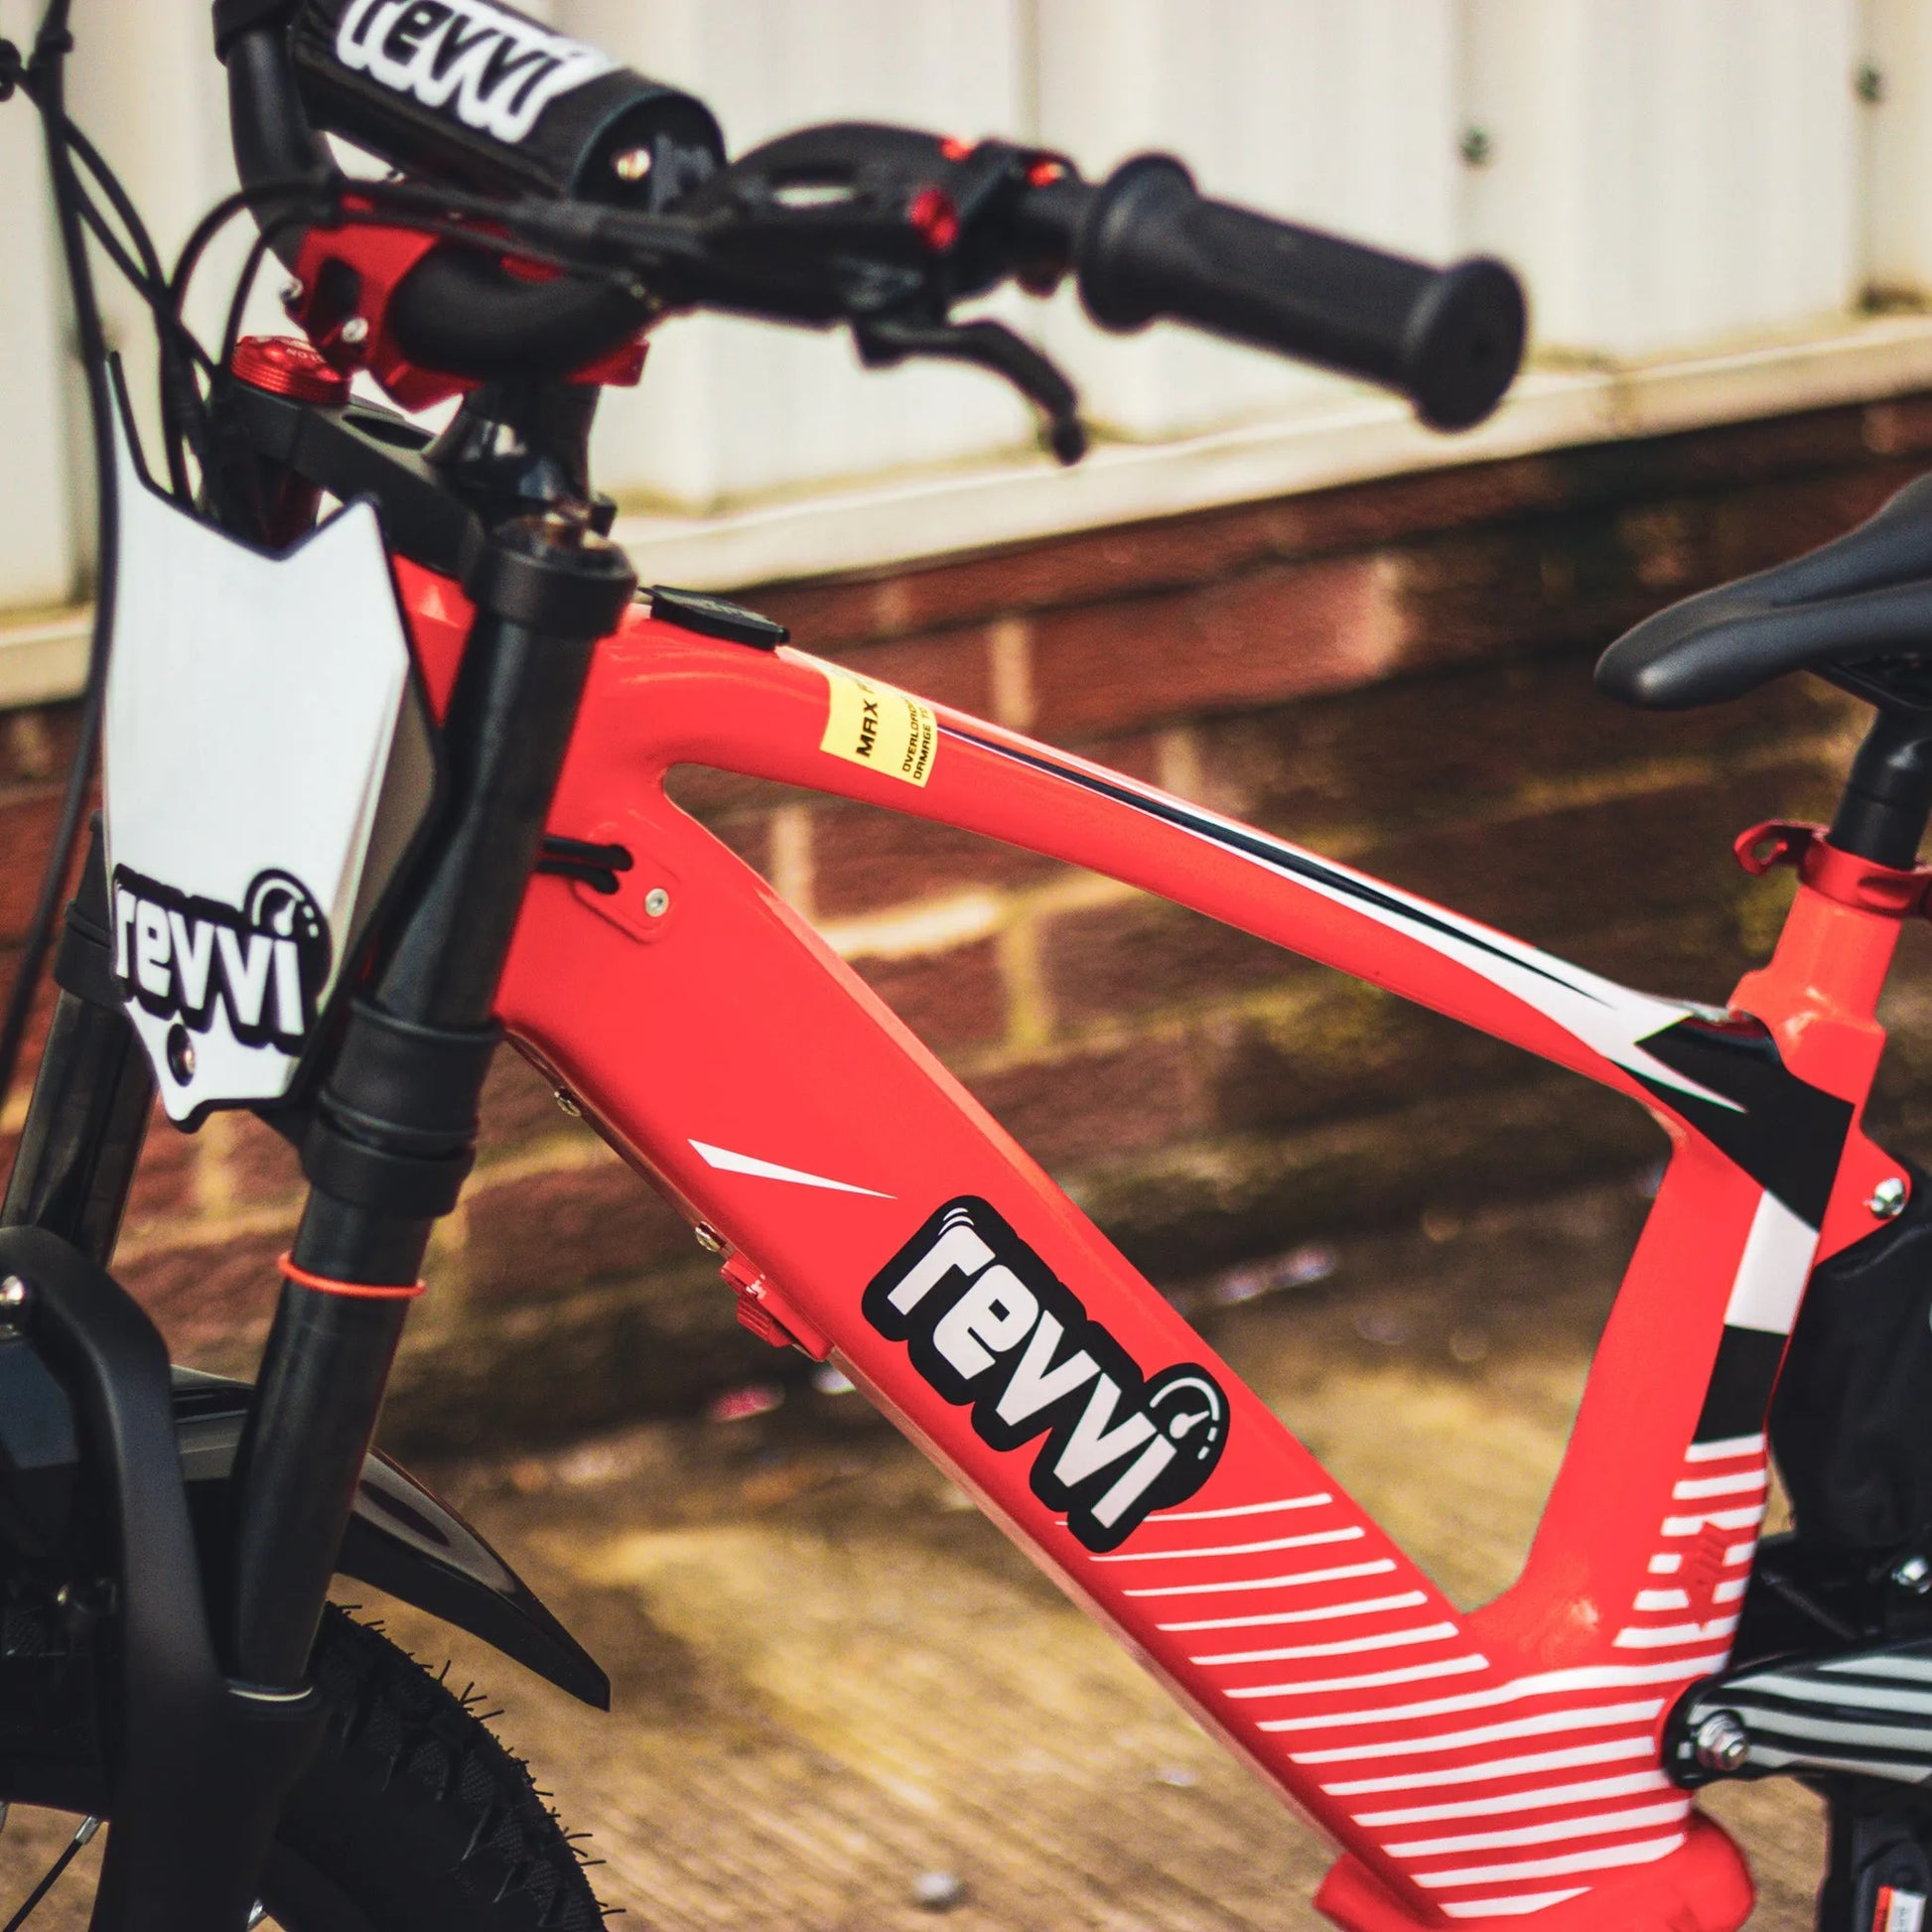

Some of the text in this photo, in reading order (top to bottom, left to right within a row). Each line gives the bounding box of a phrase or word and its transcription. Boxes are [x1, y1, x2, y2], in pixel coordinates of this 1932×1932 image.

[856, 698, 879, 758] MAX
[913, 724, 931, 780] DAMAGE
[114, 878, 319, 1035] revvi
[887, 1224, 1219, 1529] revvi
